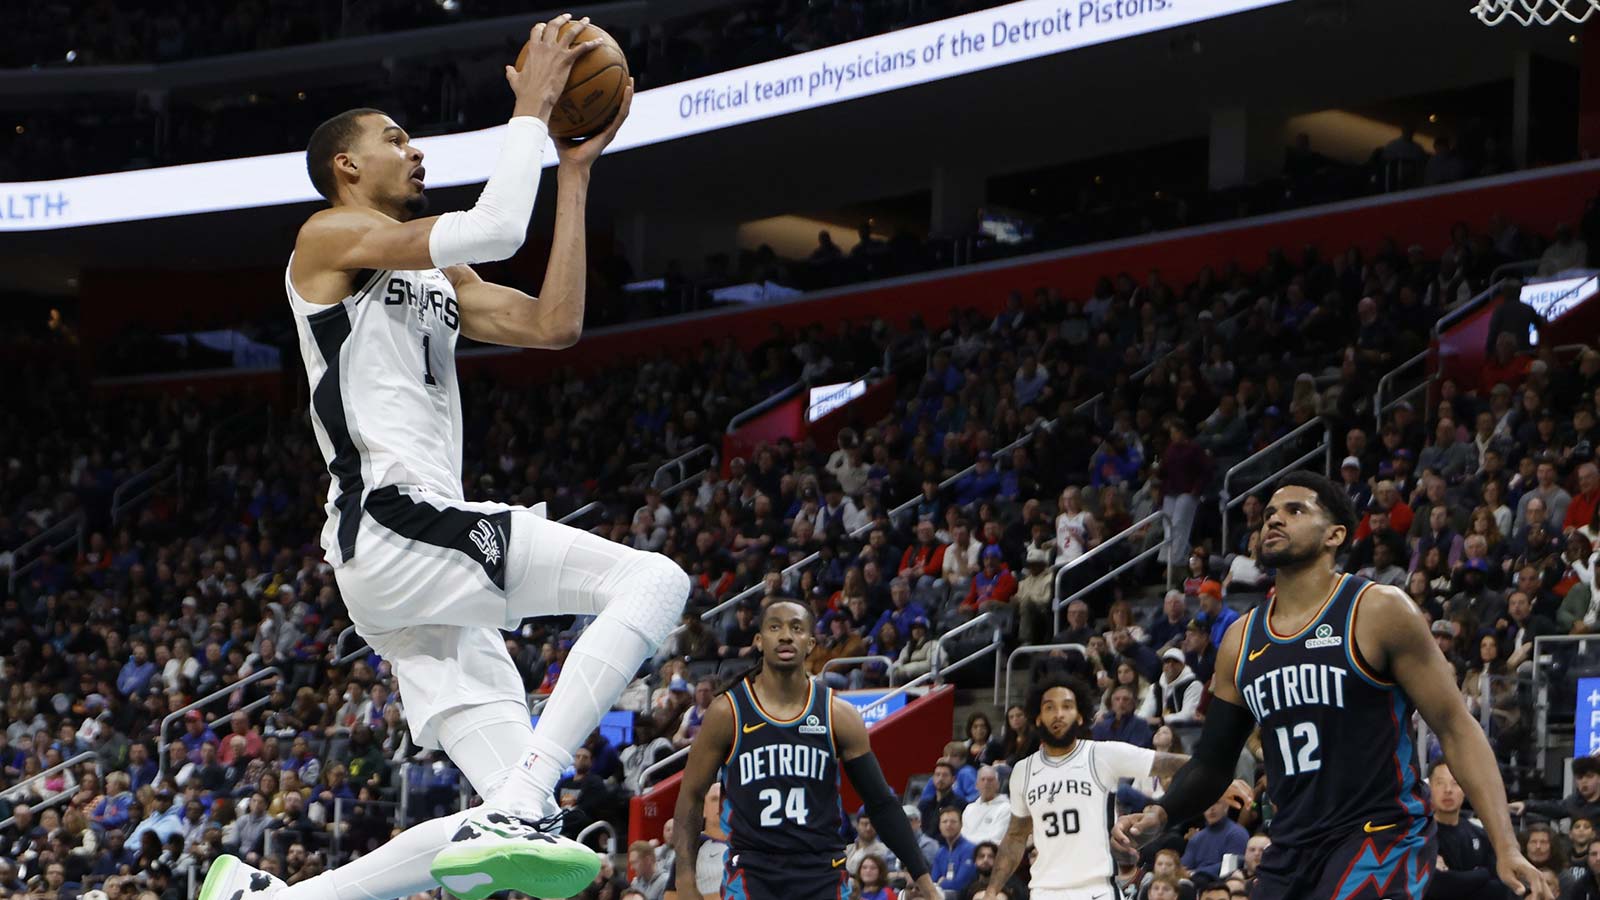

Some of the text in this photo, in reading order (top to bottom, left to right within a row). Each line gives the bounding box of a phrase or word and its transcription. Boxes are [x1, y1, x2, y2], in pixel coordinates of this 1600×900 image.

[679, 80, 749, 118] Official
[754, 74, 804, 102] team
[808, 48, 916, 96] physicians
[922, 34, 946, 63] of
[951, 29, 985, 56] the
[992, 8, 1072, 47] Detroit
[0, 191, 70, 219] LTH
[422, 335, 437, 386] 1
[1306, 638, 1341, 648] StockX
[1242, 663, 1348, 724] DETROIT
[739, 743, 830, 786] DETROIT
[1274, 721, 1322, 777] 12
[758, 787, 809, 827] 24
[1027, 779, 1093, 806] SPURS
[1042, 808, 1080, 838] 30
